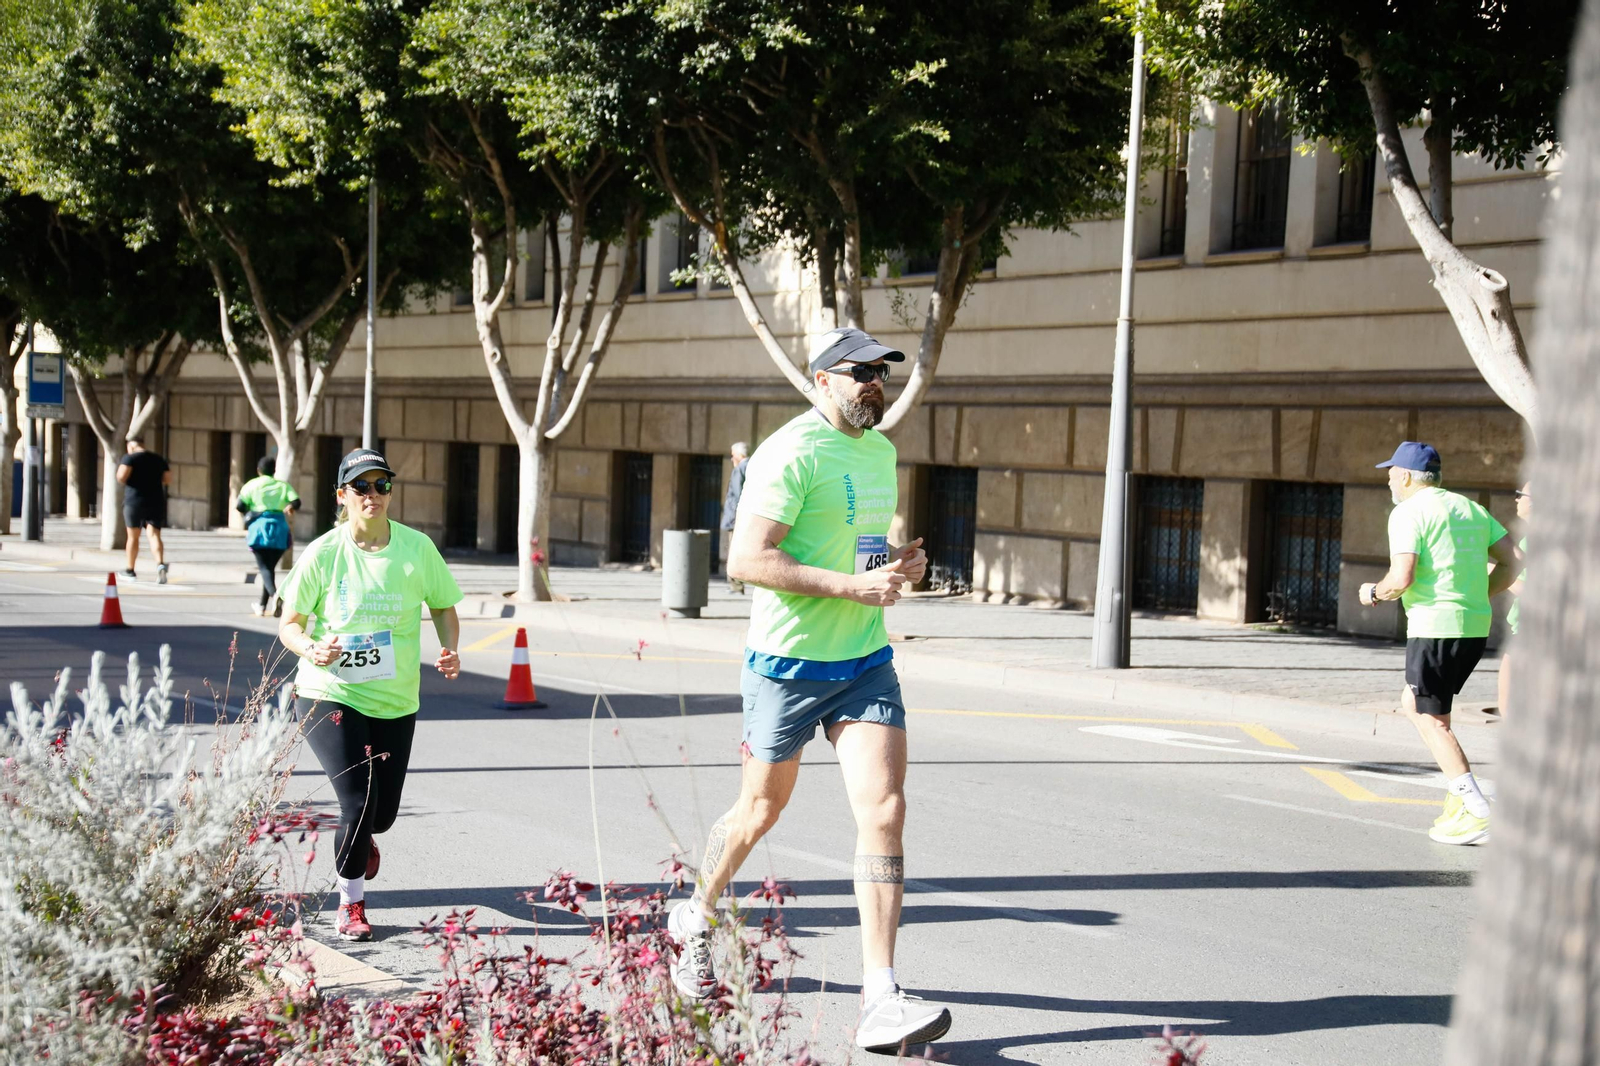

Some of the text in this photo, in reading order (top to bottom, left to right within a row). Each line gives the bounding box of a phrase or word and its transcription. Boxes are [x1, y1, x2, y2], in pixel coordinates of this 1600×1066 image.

[843, 473, 856, 526] ALMERÍA
[365, 591, 403, 601] marcha
[392, 601, 403, 612] el
[351, 611, 402, 625] cáncer
[339, 648, 381, 668] 253
